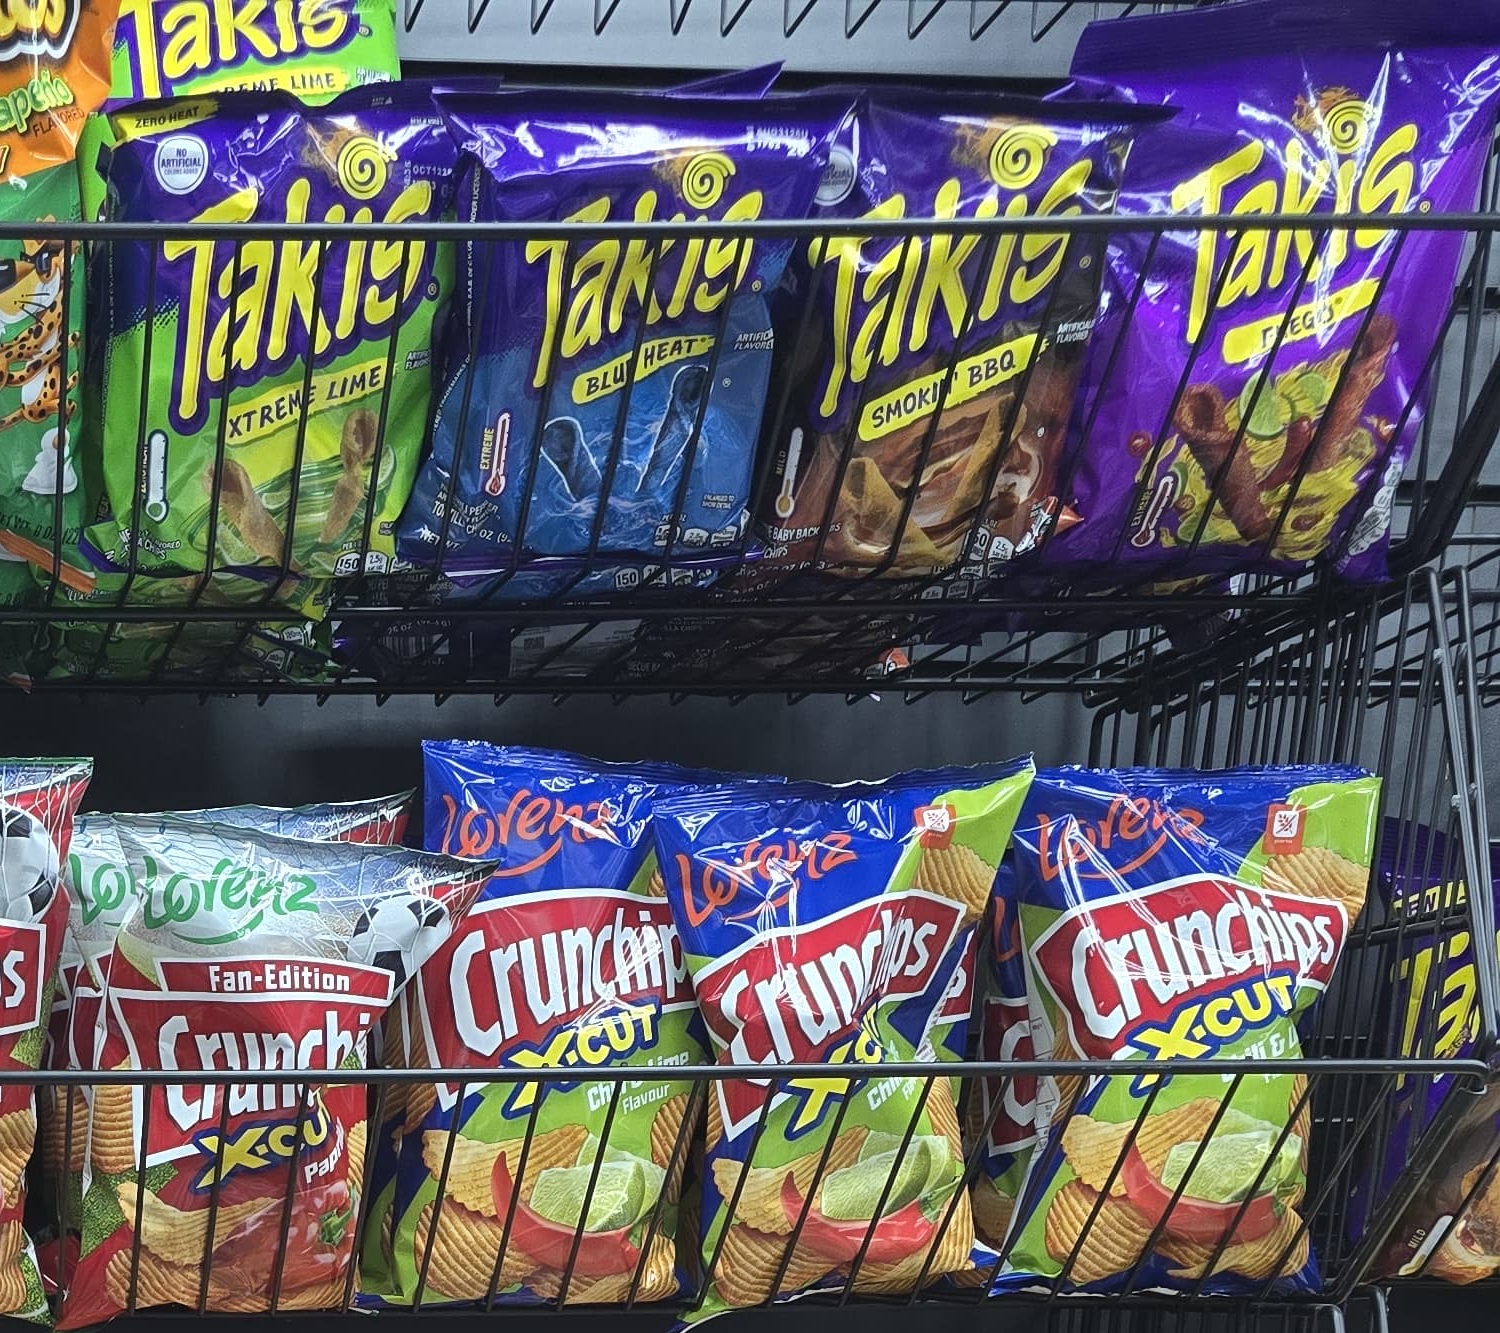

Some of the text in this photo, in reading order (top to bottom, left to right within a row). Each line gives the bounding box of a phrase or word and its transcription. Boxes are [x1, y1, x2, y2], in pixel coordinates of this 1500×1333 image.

[135, 107, 199, 128] ZERO HEAT
[161, 157, 202, 168] ARTIFICIAL
[176, 148, 188, 157] NO
[644, 338, 698, 368] HEAT
[969, 348, 1015, 386] BBQ
[328, 364, 384, 400] LIME
[480, 427, 493, 470] EXTREME
[776, 451, 786, 474] MILD
[209, 966, 351, 992] Fan-Edition
[1408, 1227, 1427, 1252] MILD
